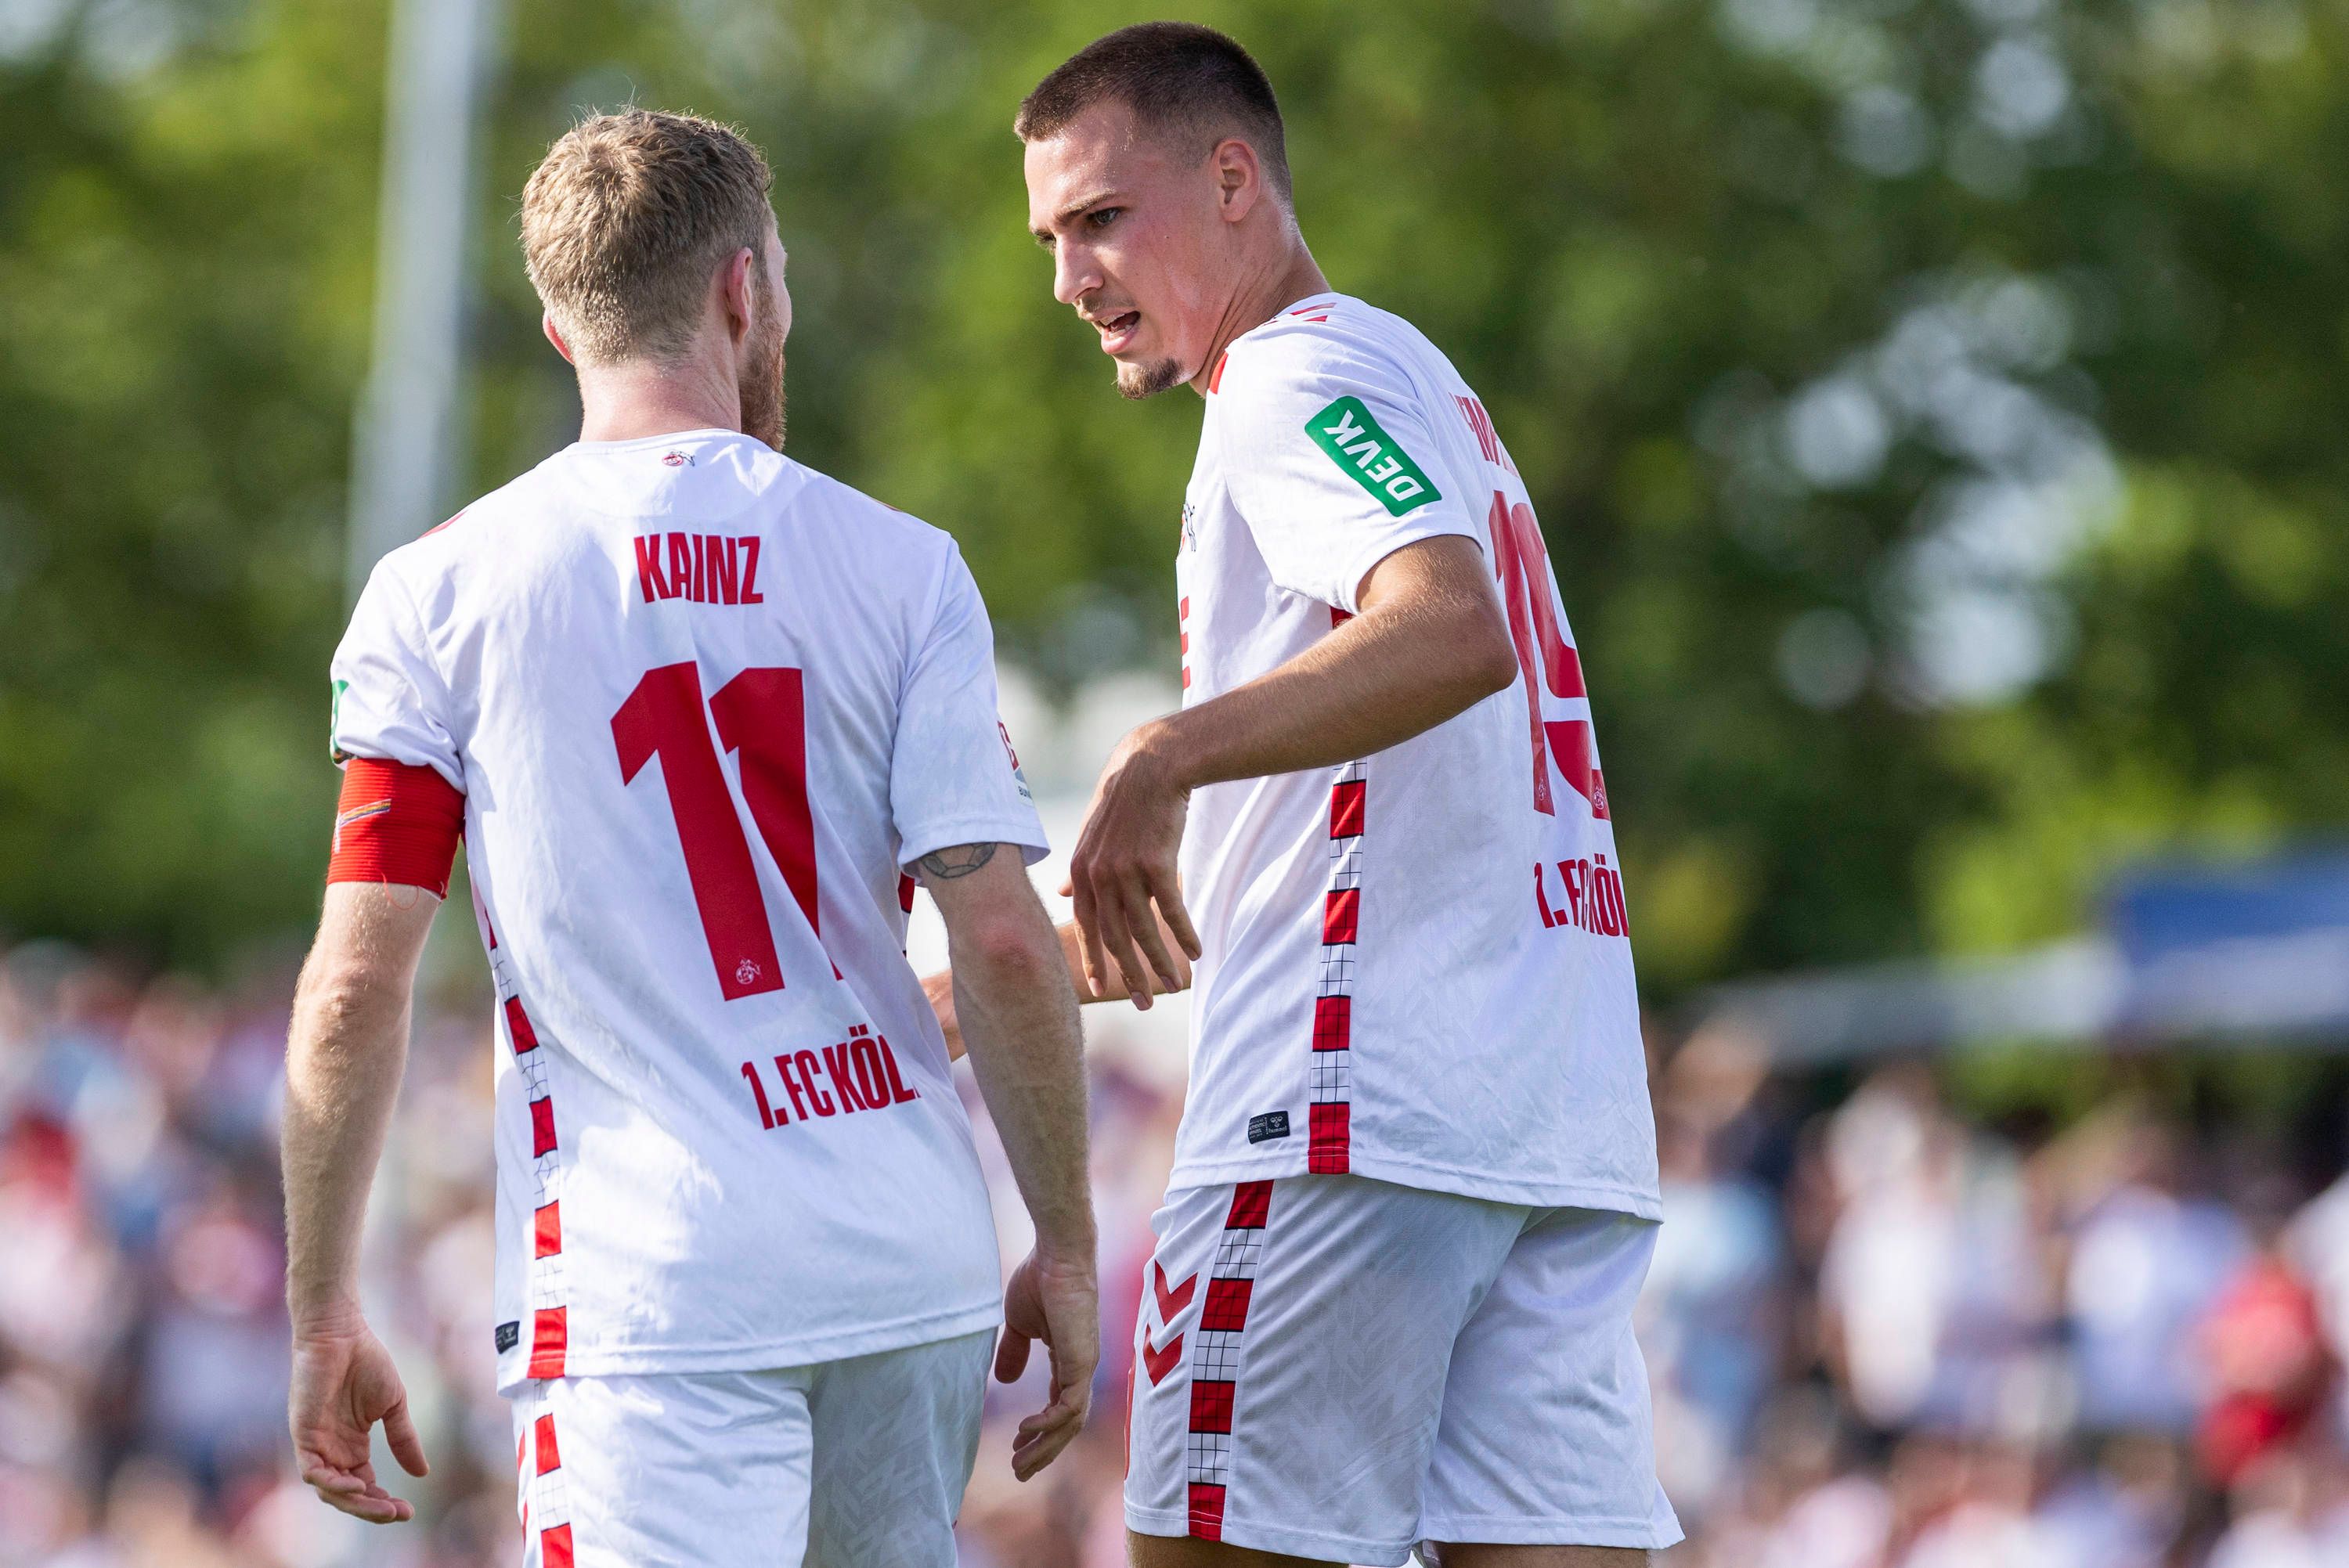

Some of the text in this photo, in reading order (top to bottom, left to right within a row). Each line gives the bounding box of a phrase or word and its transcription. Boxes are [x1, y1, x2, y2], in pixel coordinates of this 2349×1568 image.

[1322, 409, 1425, 502] DEVK
[633, 532, 764, 604] KAINZ
[611, 661, 844, 1001] 11
[1589, 853, 1629, 937] KÖL
[821, 1023, 921, 1114] KÖL
